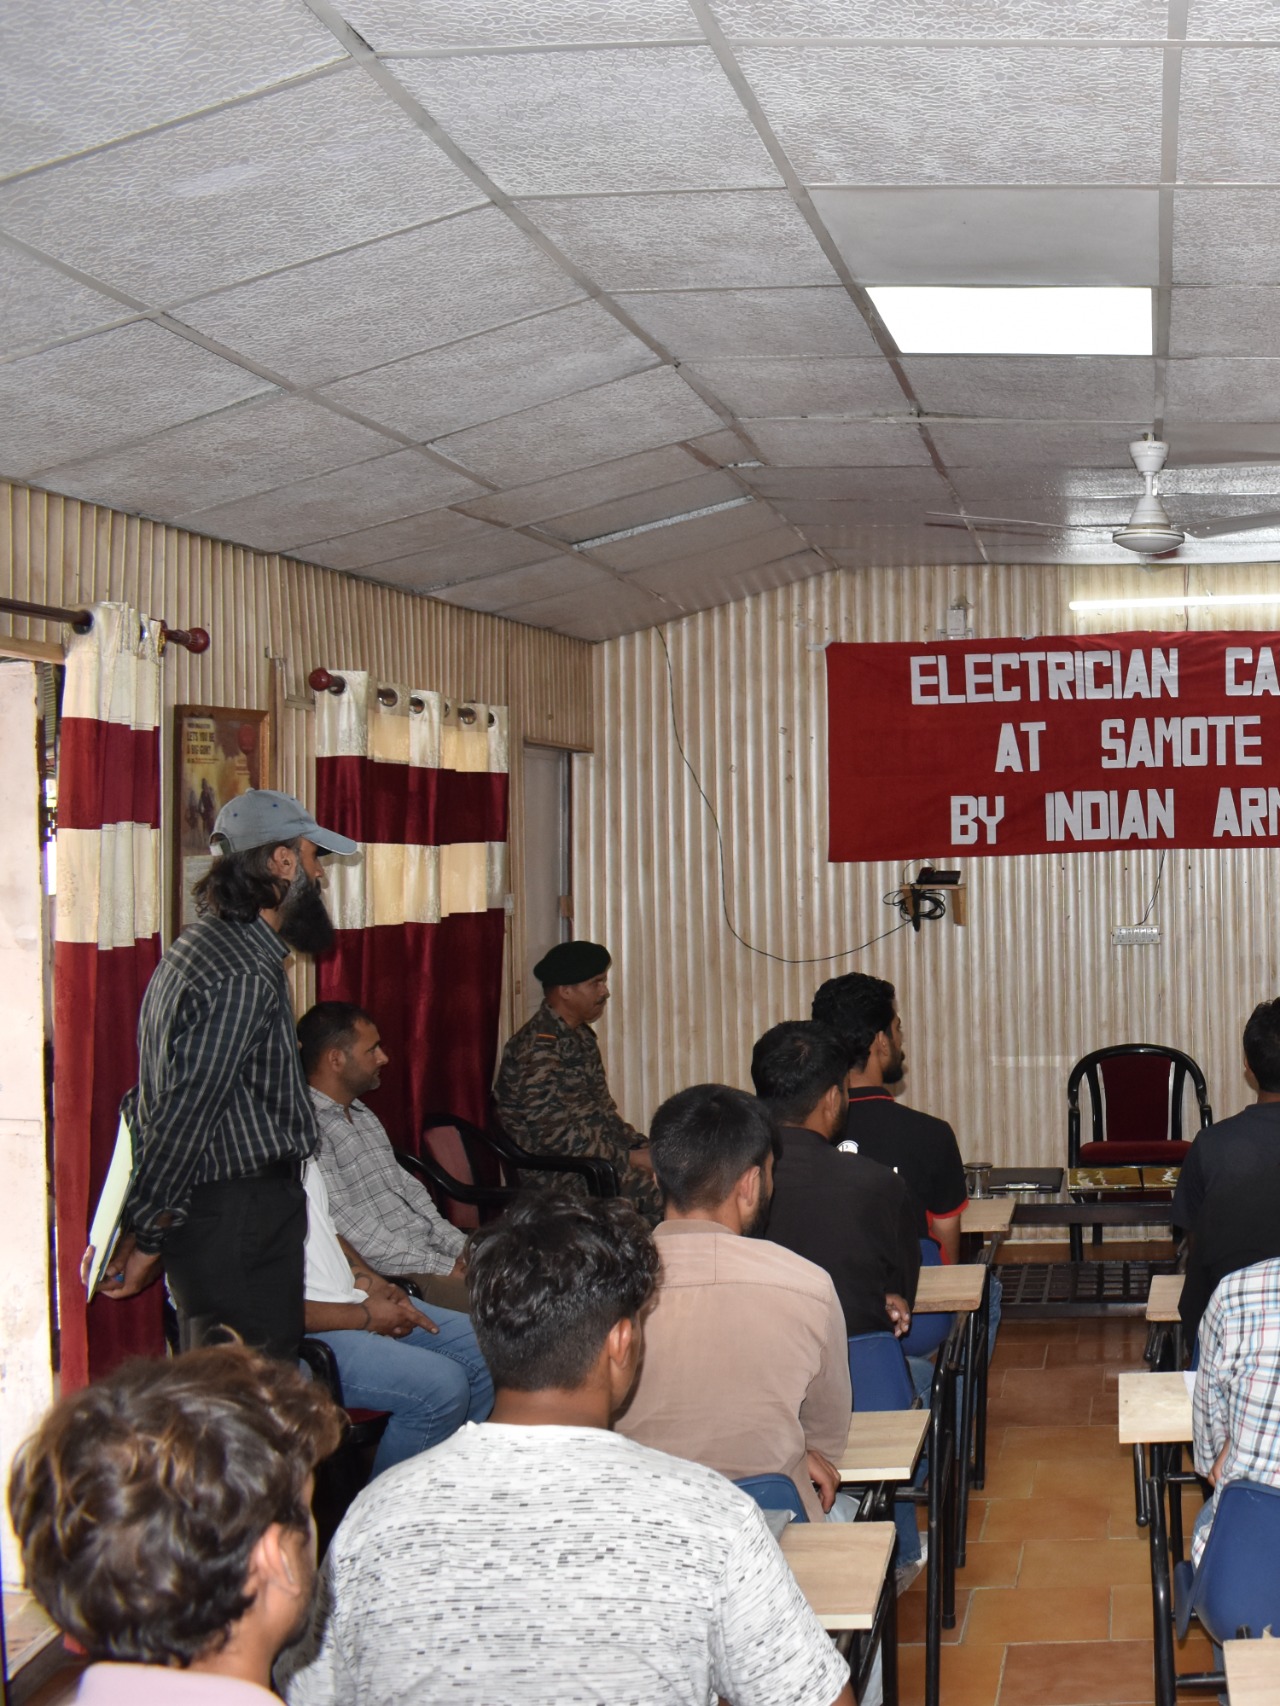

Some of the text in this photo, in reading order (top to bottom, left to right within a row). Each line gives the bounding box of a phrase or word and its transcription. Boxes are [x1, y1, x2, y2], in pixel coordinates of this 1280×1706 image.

[910, 647, 1179, 705] ELECTRICIAN
[994, 715, 1263, 773] AT SAMOTE
[950, 795, 1005, 845] BY
[1045, 788, 1175, 842] INDIAN
